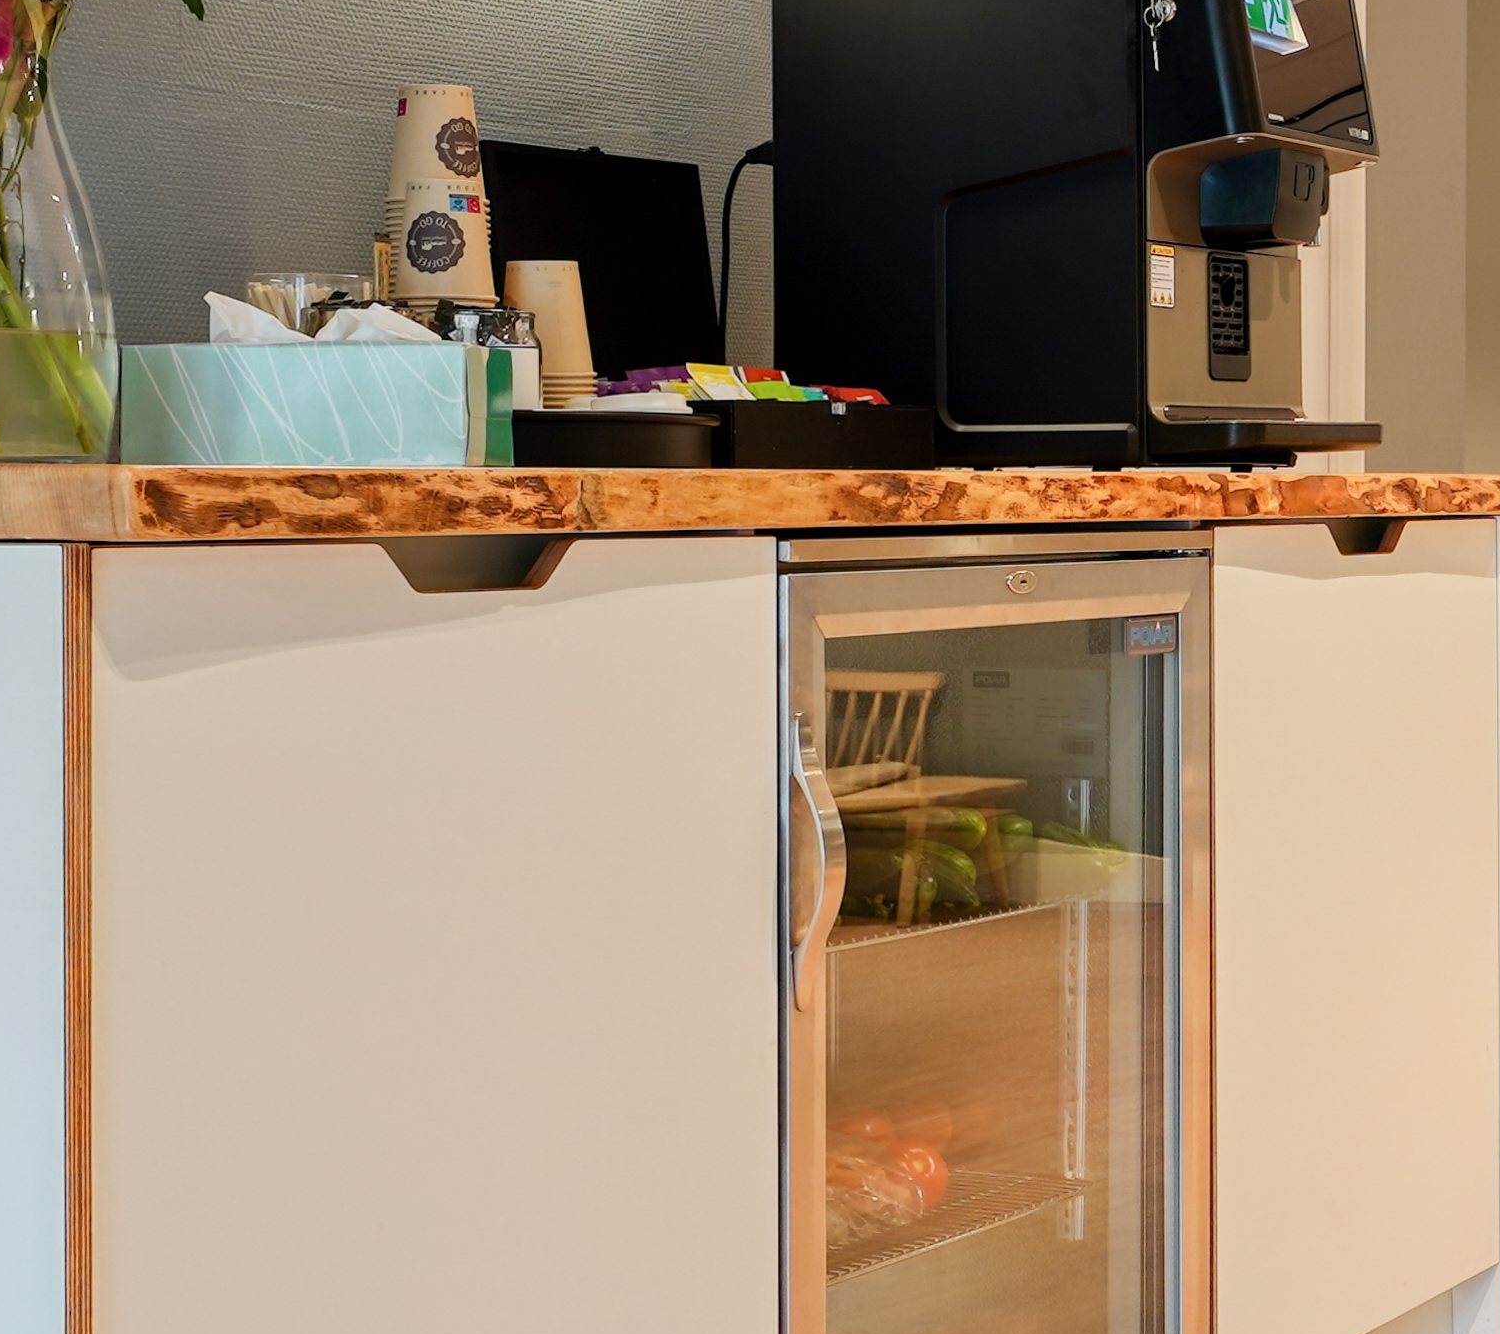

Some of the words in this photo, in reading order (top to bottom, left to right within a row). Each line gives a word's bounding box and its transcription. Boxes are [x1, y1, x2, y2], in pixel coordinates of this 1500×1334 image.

[451, 122, 463, 133] GO
[419, 216, 433, 228] GO
[435, 216, 448, 229] TO
[416, 255, 450, 269] COFFEE
